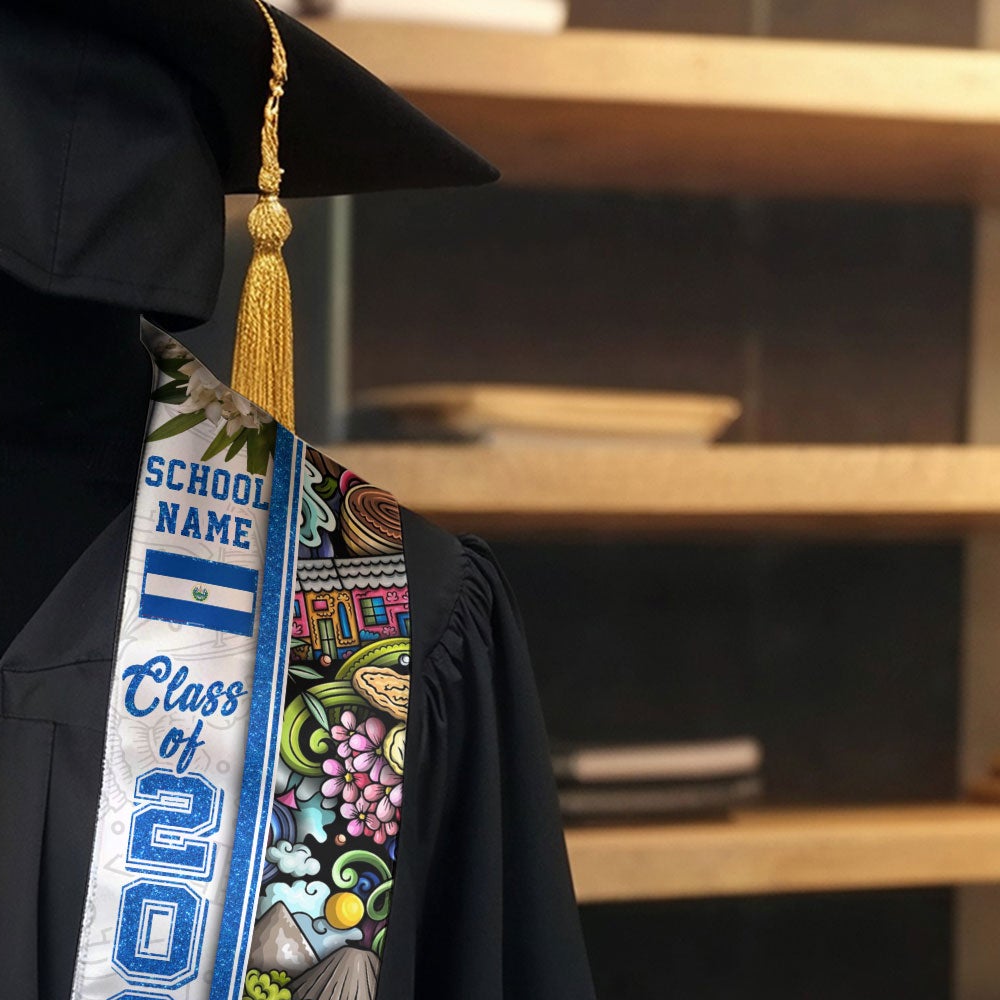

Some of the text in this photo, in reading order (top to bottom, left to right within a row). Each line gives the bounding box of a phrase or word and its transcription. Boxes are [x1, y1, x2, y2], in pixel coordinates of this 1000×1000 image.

[146, 456, 269, 510] SCHOOL
[156, 501, 252, 549] NAME
[122, 655, 248, 718] Class
[159, 719, 205, 774] of
